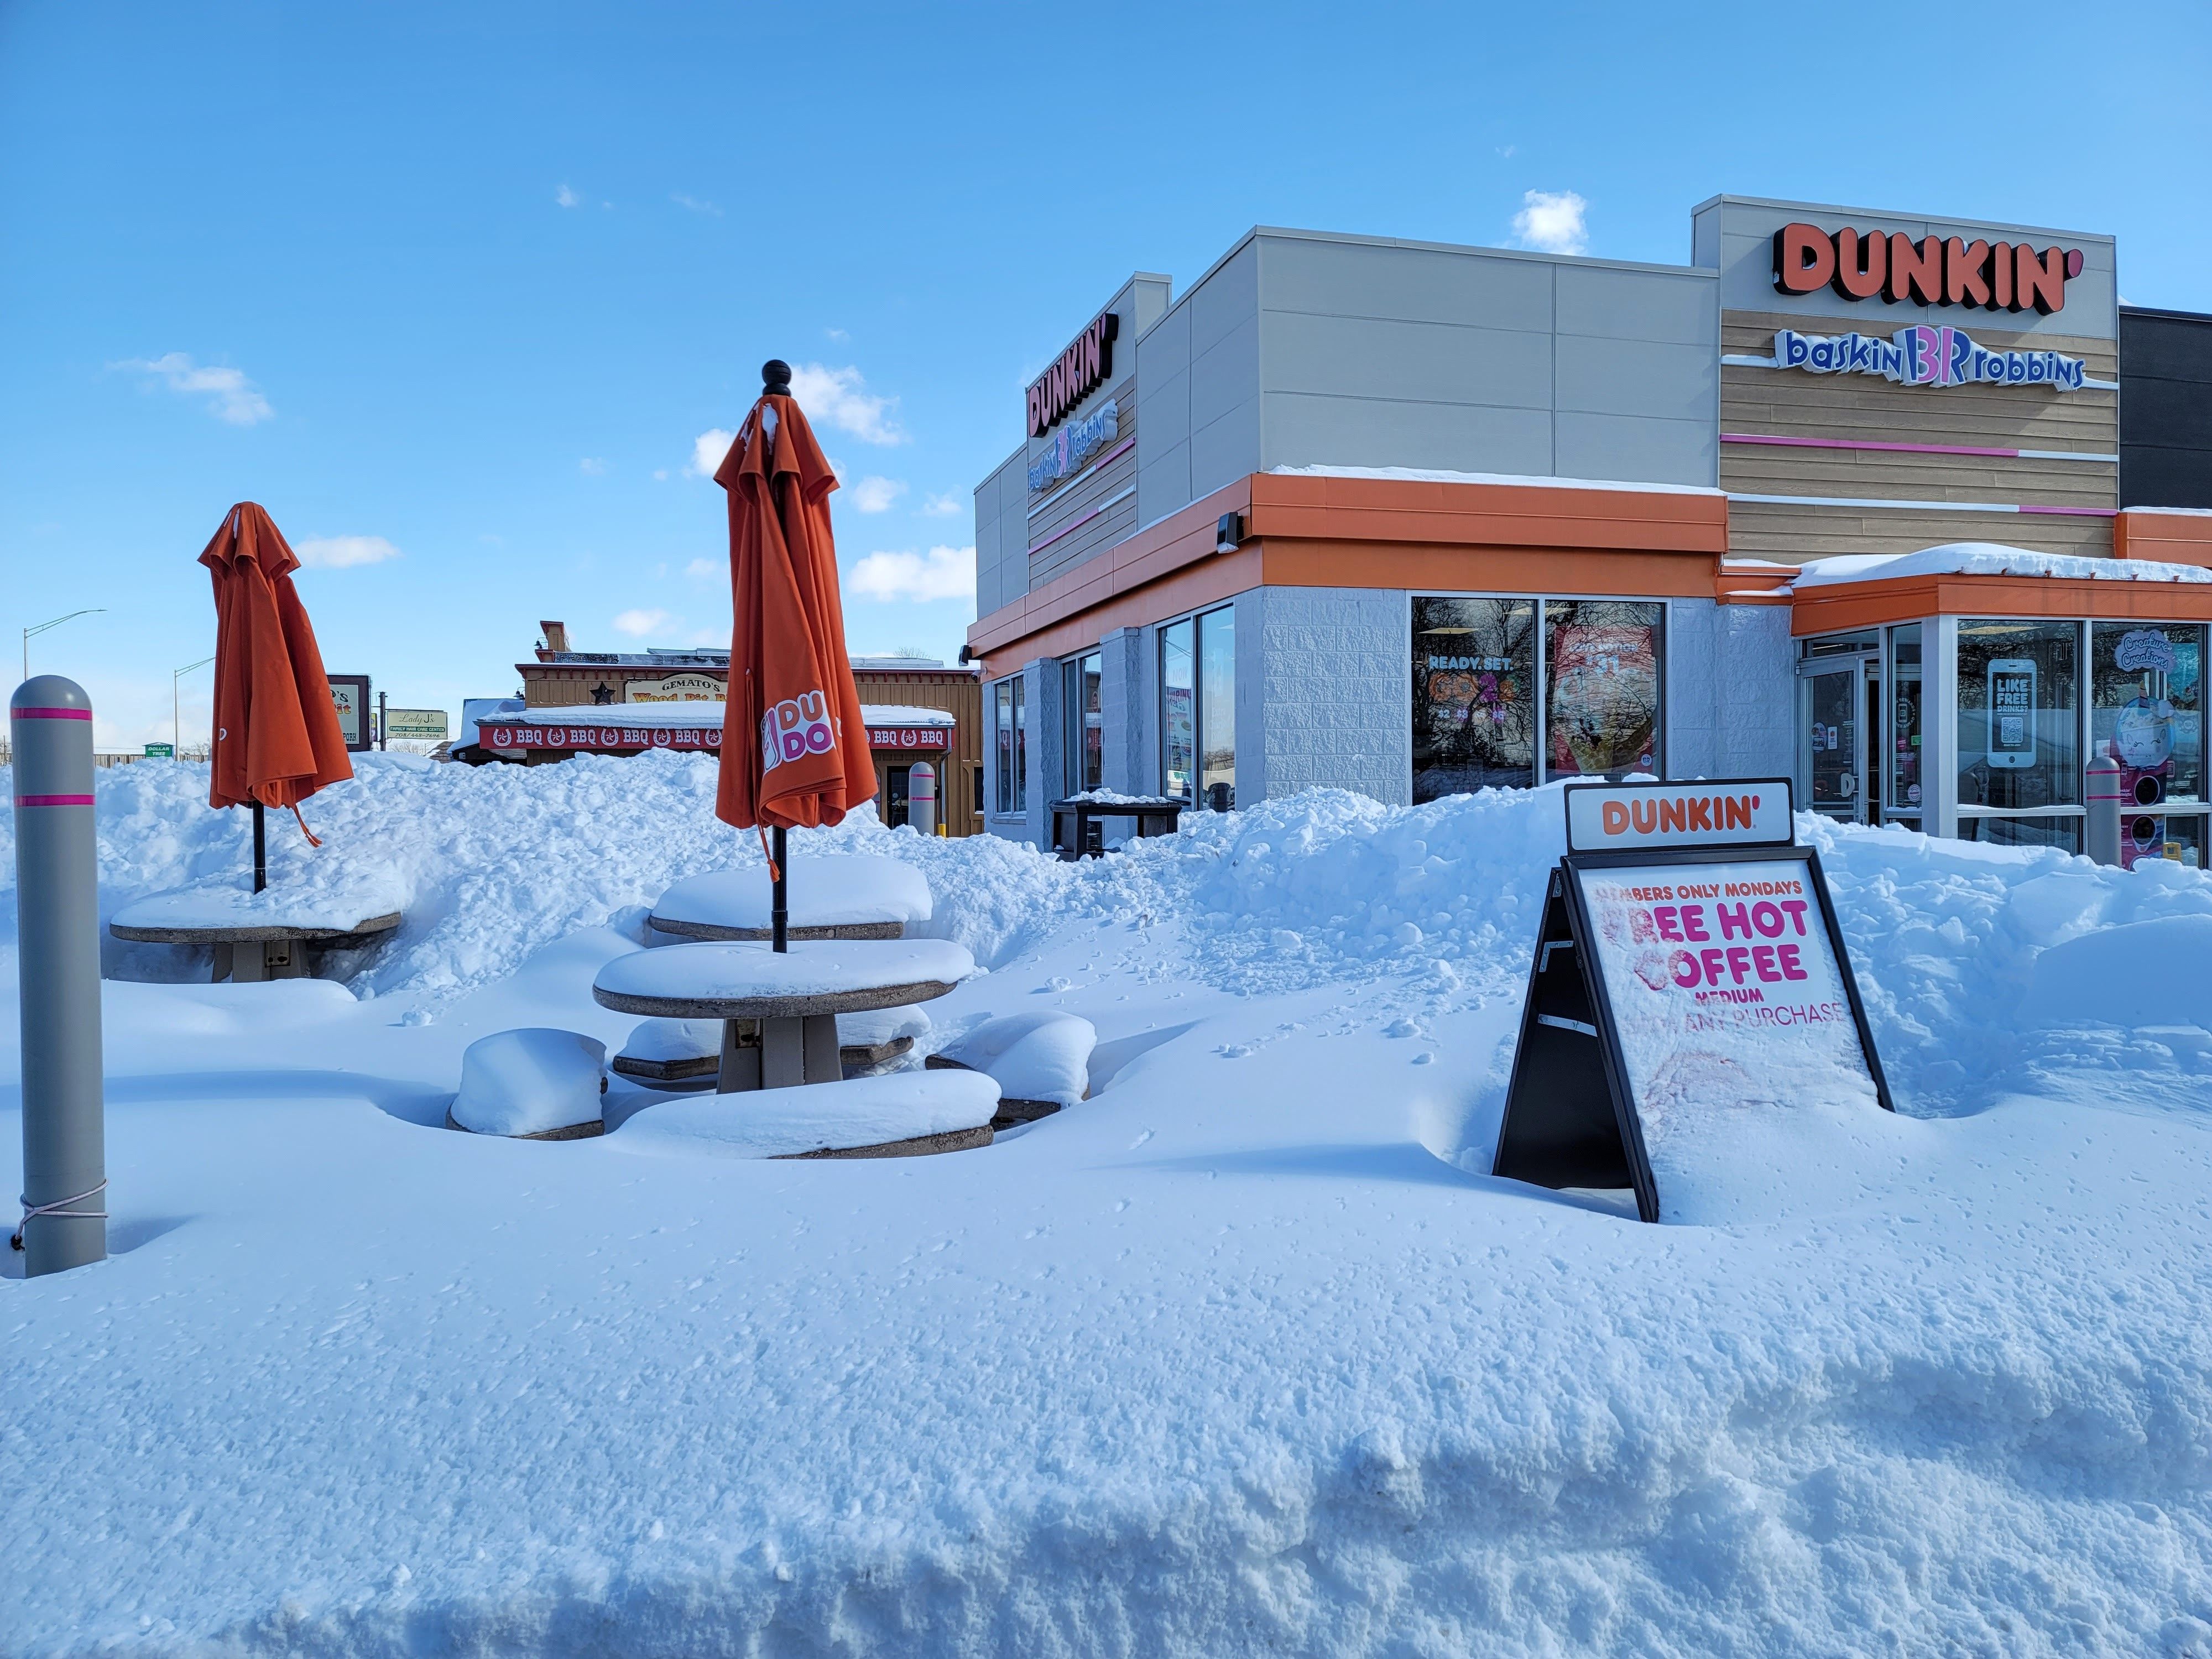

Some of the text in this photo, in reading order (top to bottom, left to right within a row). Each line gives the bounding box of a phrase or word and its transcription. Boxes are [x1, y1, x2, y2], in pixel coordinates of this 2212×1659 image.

[1774, 223, 2084, 315] DUNKIN'
[1785, 326, 2084, 390] baskin BR robbins
[1029, 313, 1115, 437] DUNKIN'
[2124, 632, 2169, 652] Creature
[1429, 656, 1514, 671] READY. SET.
[2121, 648, 2169, 669] Creations
[662, 679, 720, 692] GEMATO'S
[1997, 679, 2028, 692] LIKE
[633, 693, 677, 703] Wood
[1997, 692, 2028, 705] FREE
[335, 703, 352, 714] it
[399, 713, 436, 725] Lady J's
[516, 729, 943, 745] BBQ BBQ BBQ BBQ BBQ BBQ
[1603, 795, 1760, 836] DUNKIN'
[1677, 884, 1720, 900] ONLY
[1725, 880, 1803, 898] MONDAYS
[1601, 900, 1808, 945] REE HOT
